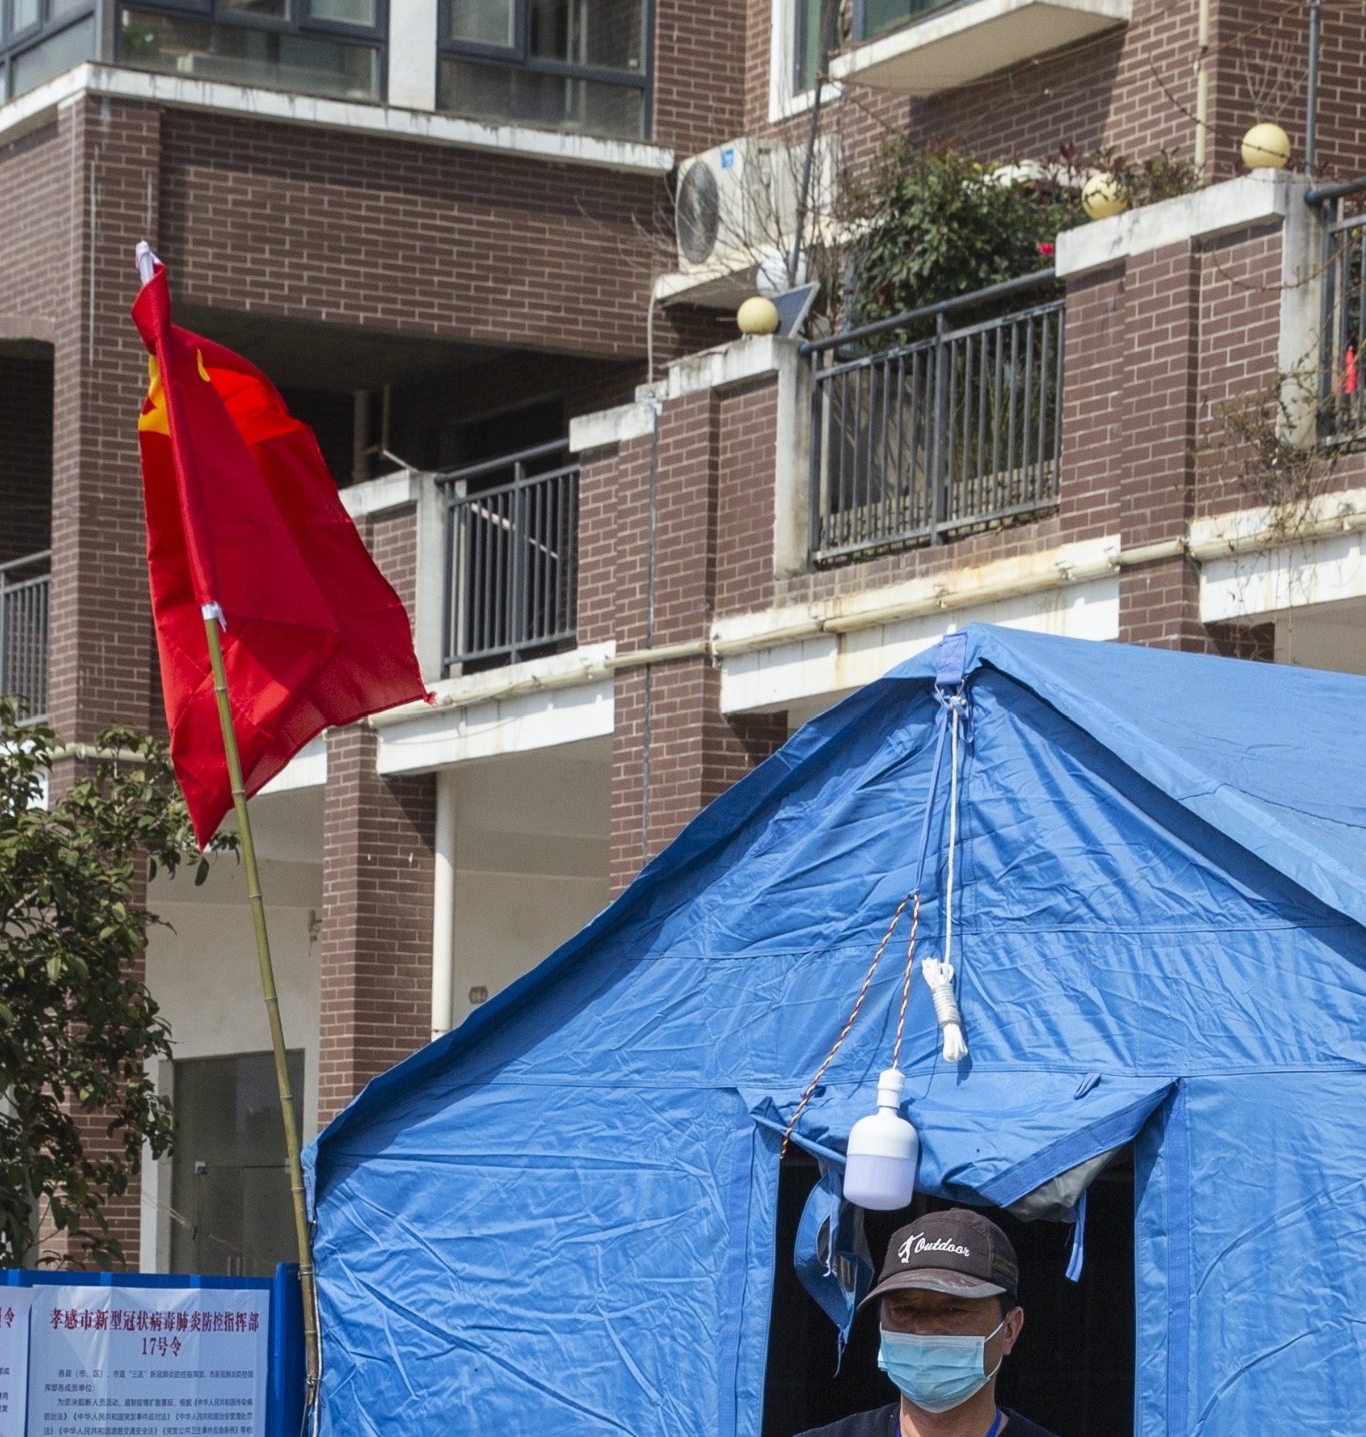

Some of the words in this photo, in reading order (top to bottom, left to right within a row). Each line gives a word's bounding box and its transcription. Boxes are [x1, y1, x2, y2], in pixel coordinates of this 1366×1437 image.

[914, 1237, 970, 1257] Outdoor
[49, 1308, 260, 1333] 孝感市新型冠状病毒肺炎防控指挥部
[141, 1335, 182, 1357] 17号令
